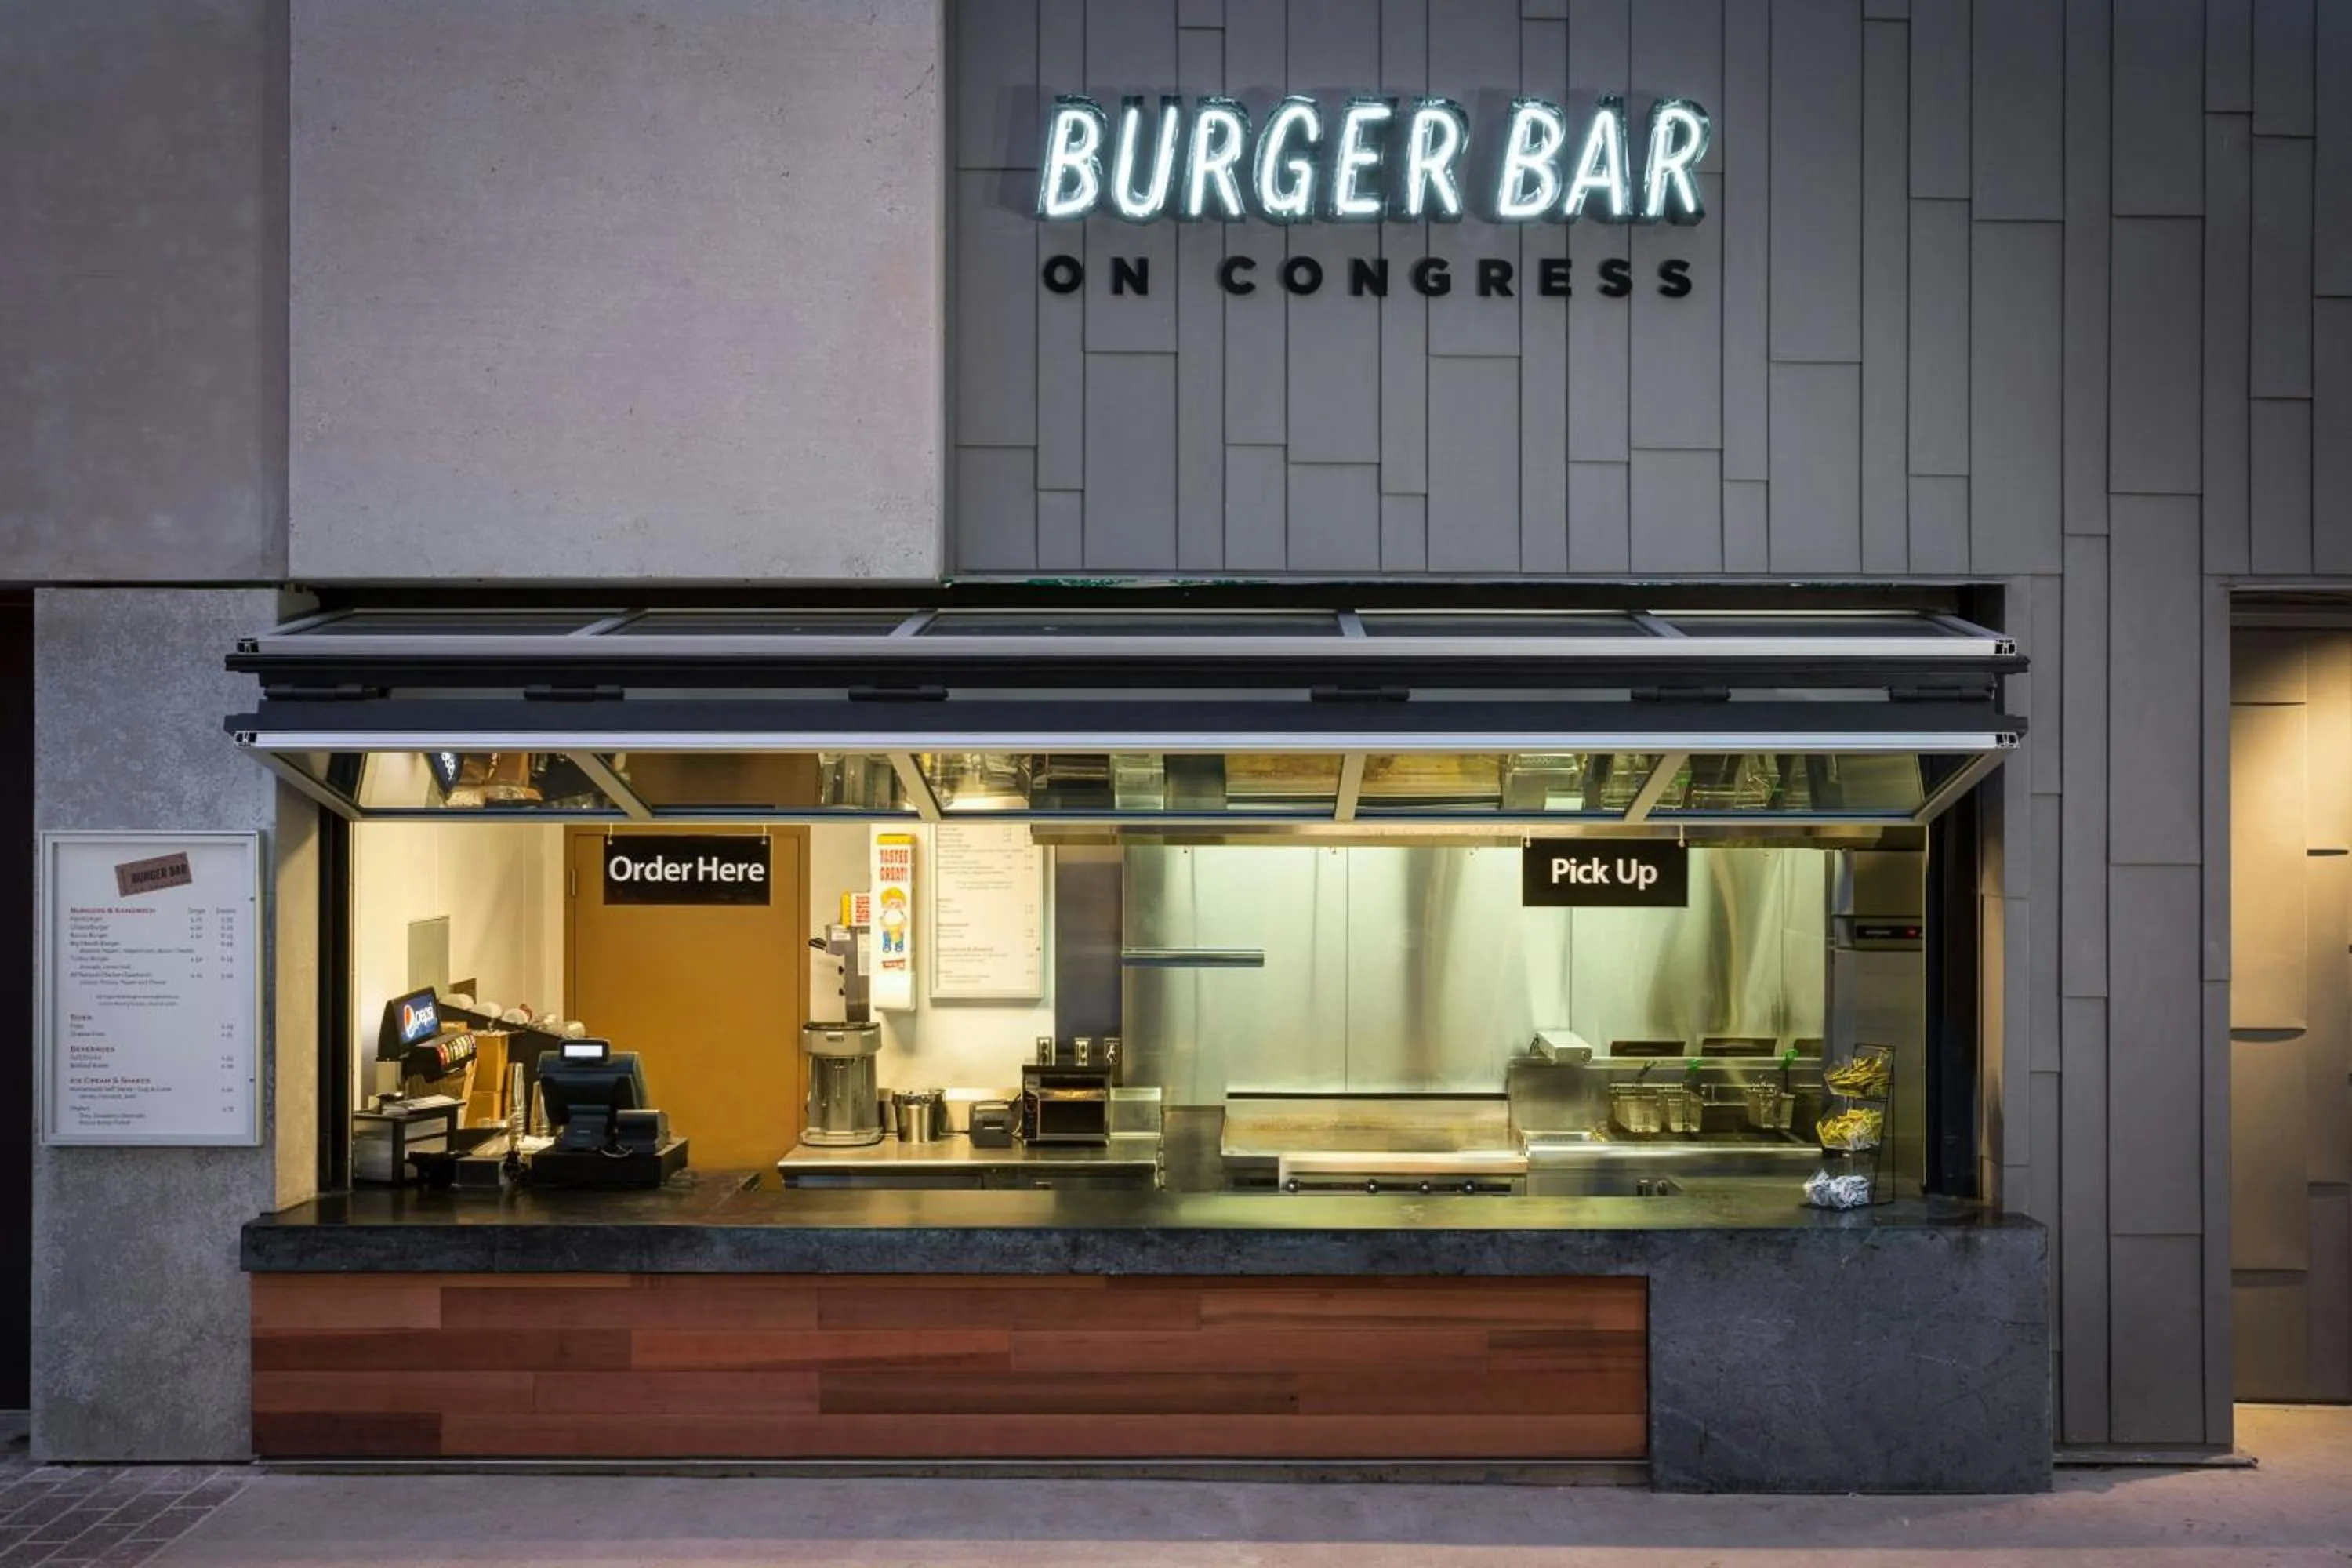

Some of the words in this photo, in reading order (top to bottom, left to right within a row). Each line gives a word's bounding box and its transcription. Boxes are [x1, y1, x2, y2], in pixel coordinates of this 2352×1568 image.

[1038, 97, 1469, 223] BURGER
[1494, 97, 1709, 224] BAR
[1044, 255, 1149, 296] ON
[1218, 255, 1692, 298] CONGRESS
[132, 868, 168, 884] BURGER
[168, 863, 187, 877] BAR
[609, 855, 693, 882] Order
[698, 856, 765, 882] Here
[1551, 858, 1610, 884] Pick
[1617, 858, 1657, 890] Up
[415, 1001, 434, 1026] pepsi
